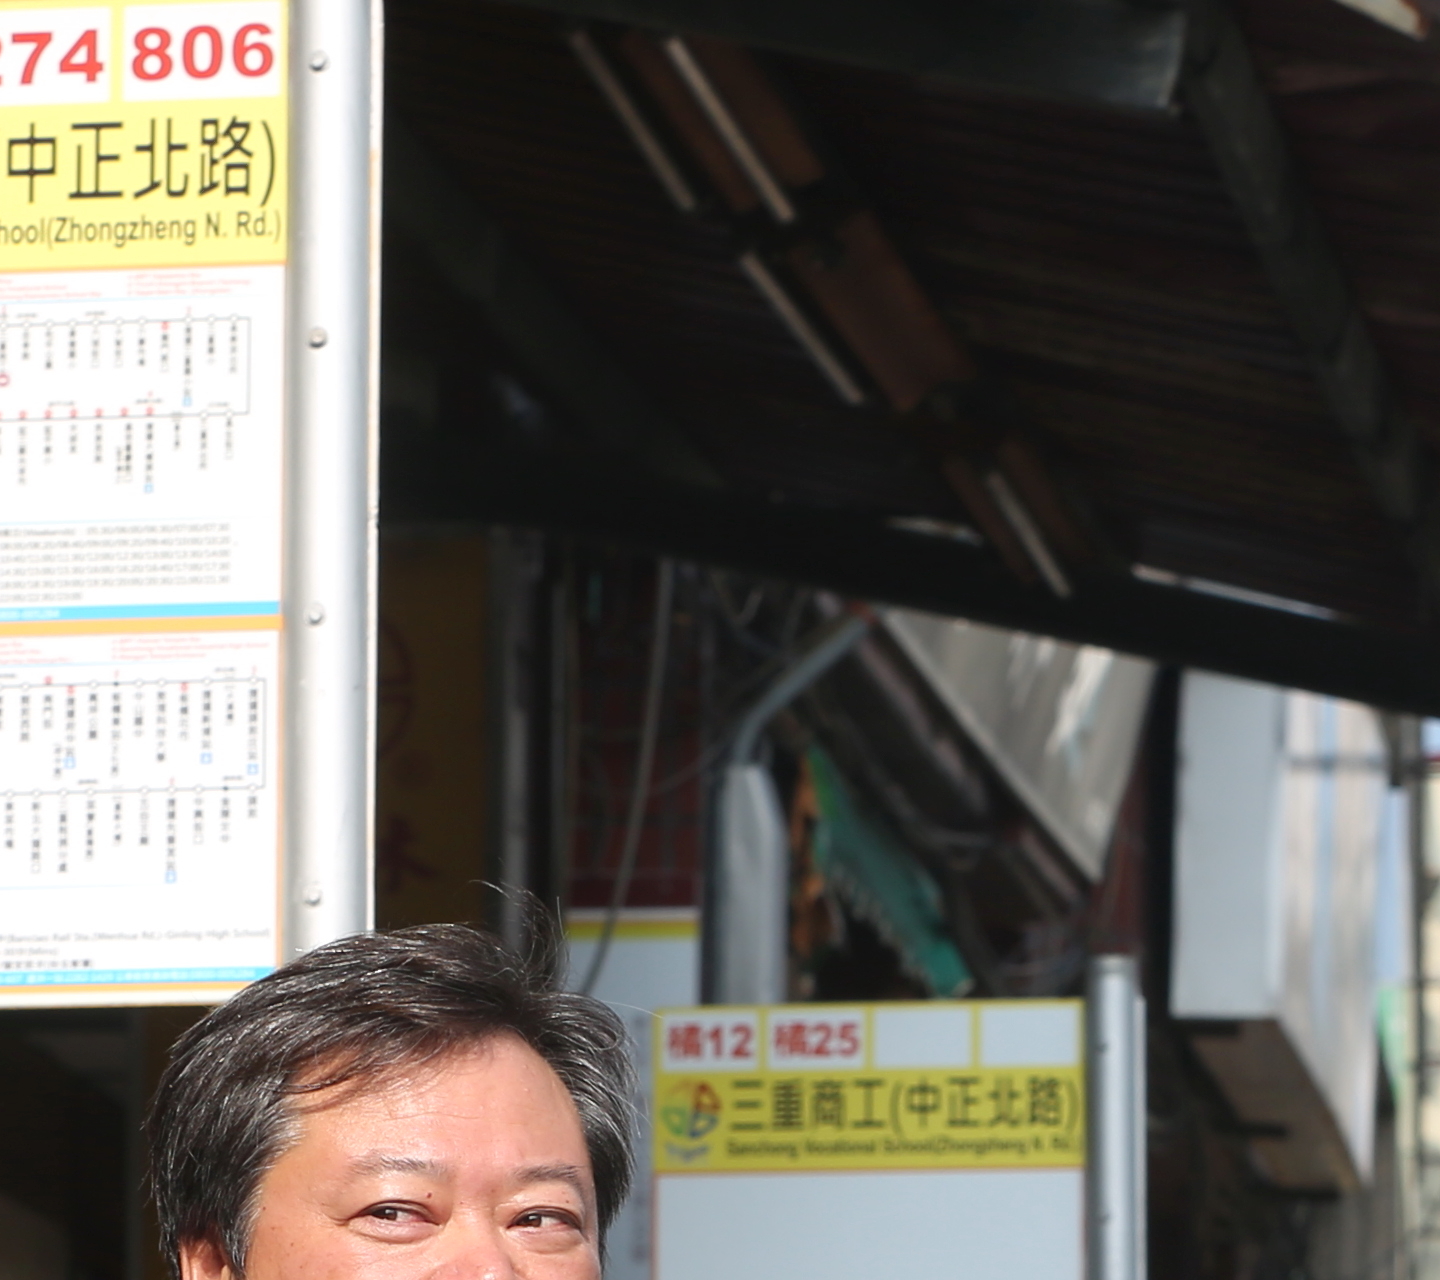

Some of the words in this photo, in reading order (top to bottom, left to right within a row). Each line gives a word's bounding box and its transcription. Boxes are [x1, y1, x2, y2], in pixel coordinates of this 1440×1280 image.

[131, 22, 275, 81] 806
[205, 214, 228, 240] N.
[236, 209, 282, 242] Rd.)
[668, 1021, 753, 1060] 橘12
[774, 1020, 861, 1060] 橘25
[730, 1076, 1080, 1136] 三重商工(中正北路)
